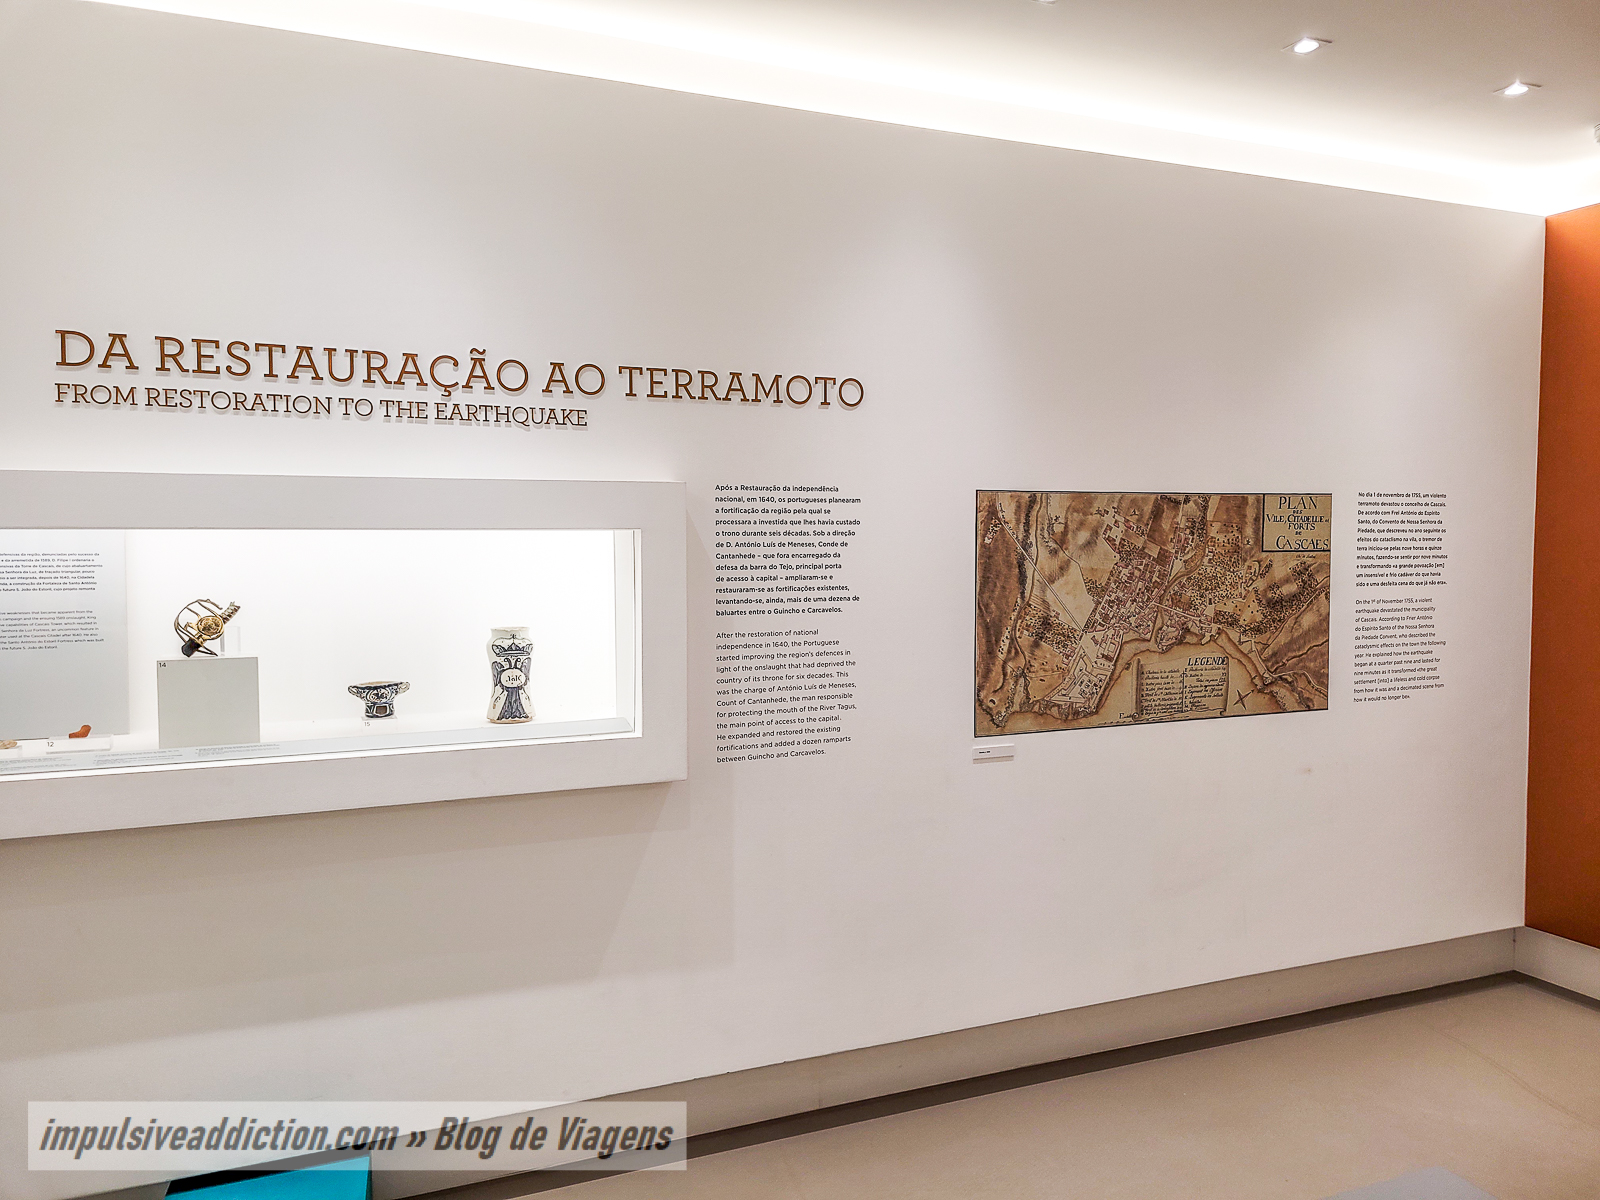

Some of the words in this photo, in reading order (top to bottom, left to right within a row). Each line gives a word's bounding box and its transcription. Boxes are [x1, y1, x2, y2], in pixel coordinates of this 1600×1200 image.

[55, 329, 139, 370] DA
[155, 335, 529, 397] RESTAURAÇÃO
[541, 362, 606, 396] AO
[618, 365, 865, 408] TERRAMOTO
[54, 383, 138, 407] FROM
[145, 387, 333, 416] RESTORATION
[338, 397, 374, 417] TO
[380, 399, 429, 420] THE
[434, 402, 588, 428] EARTHQUAKE
[714, 484, 733, 493] Após
[740, 484, 781, 493] Restauração
[792, 485, 839, 494] independência
[714, 495, 746, 504] nacional,
[758, 496, 777, 504] 1640,
[787, 496, 827, 505] portugueses
[828, 496, 861, 505] planearam
[1278, 496, 1318, 510] PLAN
[720, 507, 760, 515] fortificação
[770, 507, 792, 515] região
[792, 507, 807, 515] pela
[808, 507, 823, 516] qual
[1287, 514, 1325, 523] CITADELLE
[1288, 523, 1316, 531] FORTS
[831, 529, 856, 537] direção
[715, 540, 725, 548] de
[725, 540, 733, 548] D.
[734, 540, 762, 548] António
[787, 540, 817, 549] Meneses,
[715, 551, 756, 559] Cantanhede
[776, 551, 790, 559] fora
[791, 551, 832, 560] encarregado
[715, 563, 738, 571] defesa
[778, 562, 795, 571] Tejo,
[795, 562, 824, 571] principal
[824, 562, 842, 571] porta
[750, 574, 755, 582] à
[755, 574, 779, 583] capital
[784, 573, 828, 582] ampliaram-se
[715, 585, 766, 593] restauraram-se
[775, 585, 816, 594] fortificações
[816, 584, 850, 593] existentes,
[715, 596, 765, 606] levantando-se,
[765, 596, 786, 605] ainda,
[803, 595, 812, 603] de
[827, 594, 851, 602] dezena
[851, 594, 860, 602] de
[715, 608, 747, 616] baluartes
[748, 607, 766, 615] entre
[806, 606, 843, 614] Carcavelos.
[716, 631, 734, 639] After
[734, 630, 746, 638] the
[747, 629, 784, 638] restoration
[792, 628, 819, 636] national
[716, 641, 764, 651] independence
[772, 640, 790, 649] 1640,
[803, 639, 840, 648] Portuguese
[716, 653, 740, 661] started
[741, 651, 775, 661] improving
[776, 651, 788, 659] the
[788, 650, 814, 659] region's
[815, 649, 844, 657] defences
[844, 648, 851, 656] in
[1187, 656, 1228, 667] LEGENDE
